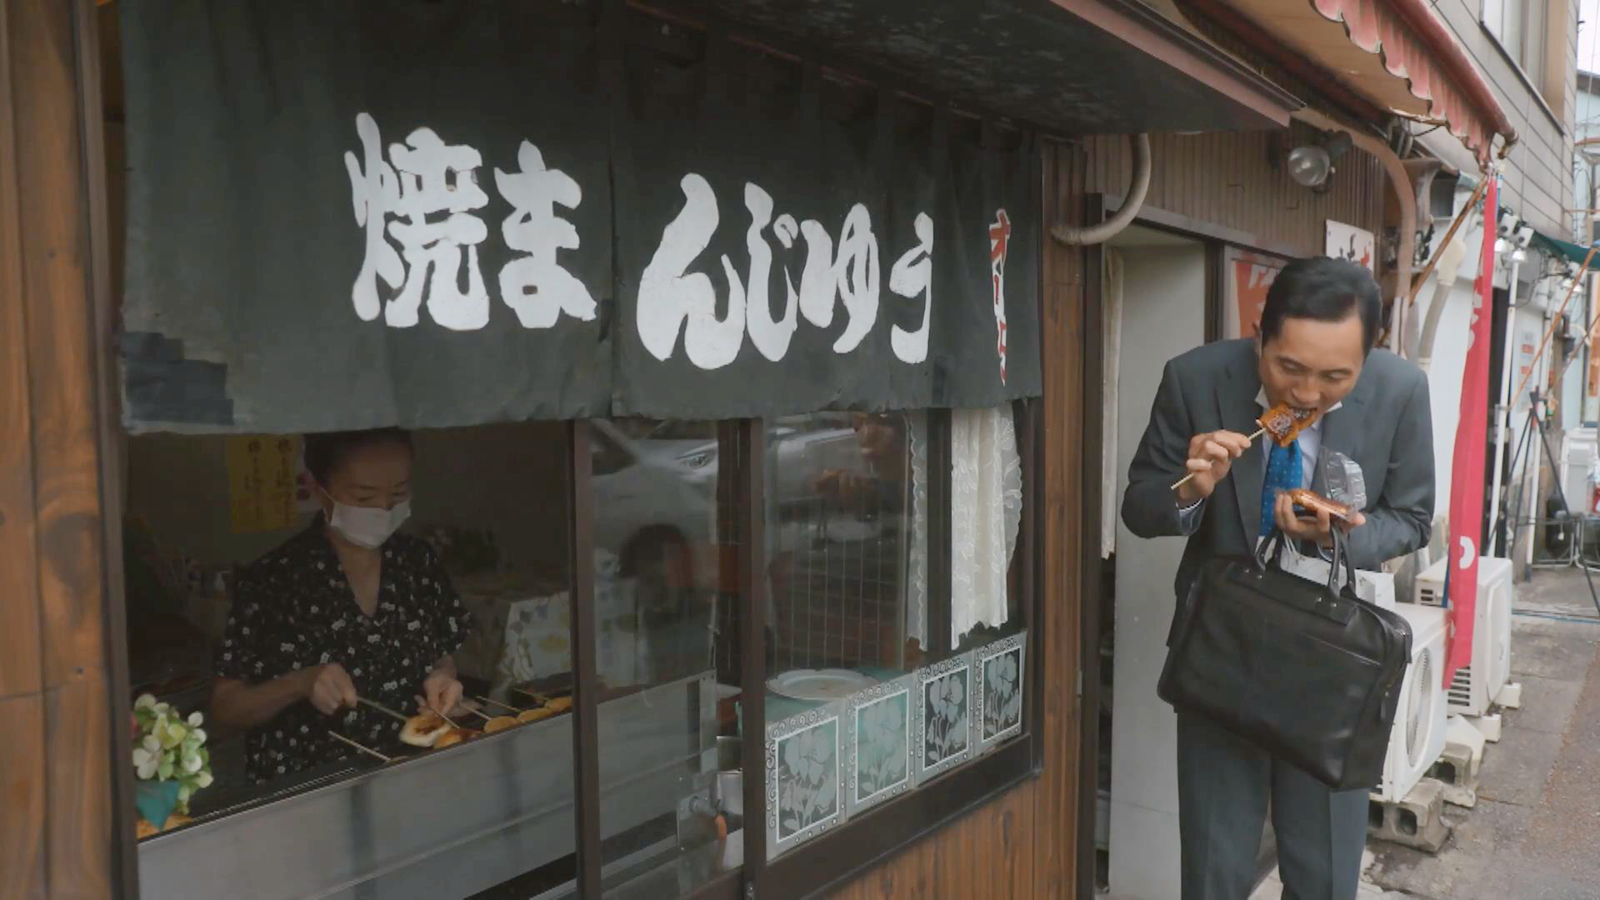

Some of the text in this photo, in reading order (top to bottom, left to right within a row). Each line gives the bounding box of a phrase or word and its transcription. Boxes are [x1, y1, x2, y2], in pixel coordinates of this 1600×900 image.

[345, 113, 933, 370] 焼まんじゅう
